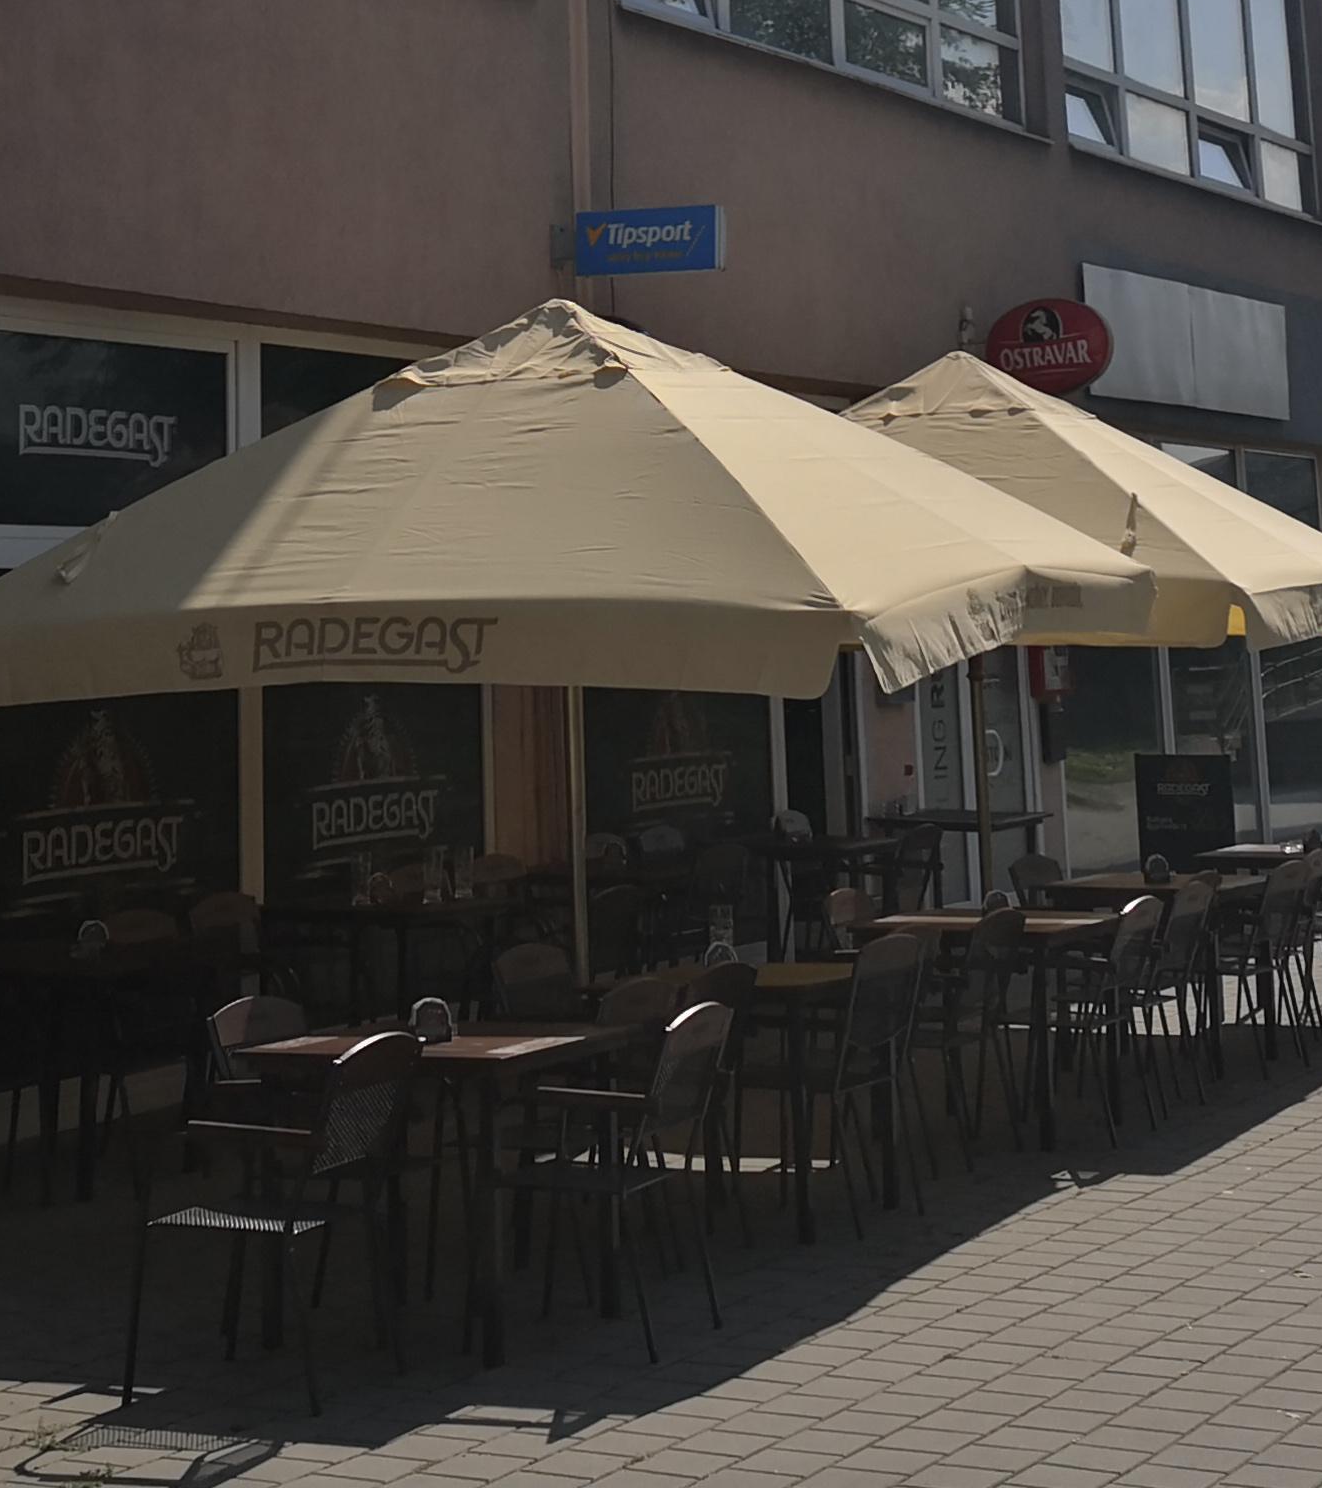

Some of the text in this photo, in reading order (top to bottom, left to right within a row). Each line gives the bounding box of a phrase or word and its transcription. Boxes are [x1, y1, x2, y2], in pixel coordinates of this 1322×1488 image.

[607, 220, 693, 250] Tipsport
[999, 339, 1093, 372] OSTRAVAR
[18, 403, 176, 468] RADEGAST
[252, 616, 498, 674] RADEGAST
[631, 762, 727, 813] RADEGAST
[312, 789, 438, 850] RADEGAST
[22, 816, 184, 885] RADEGAST
